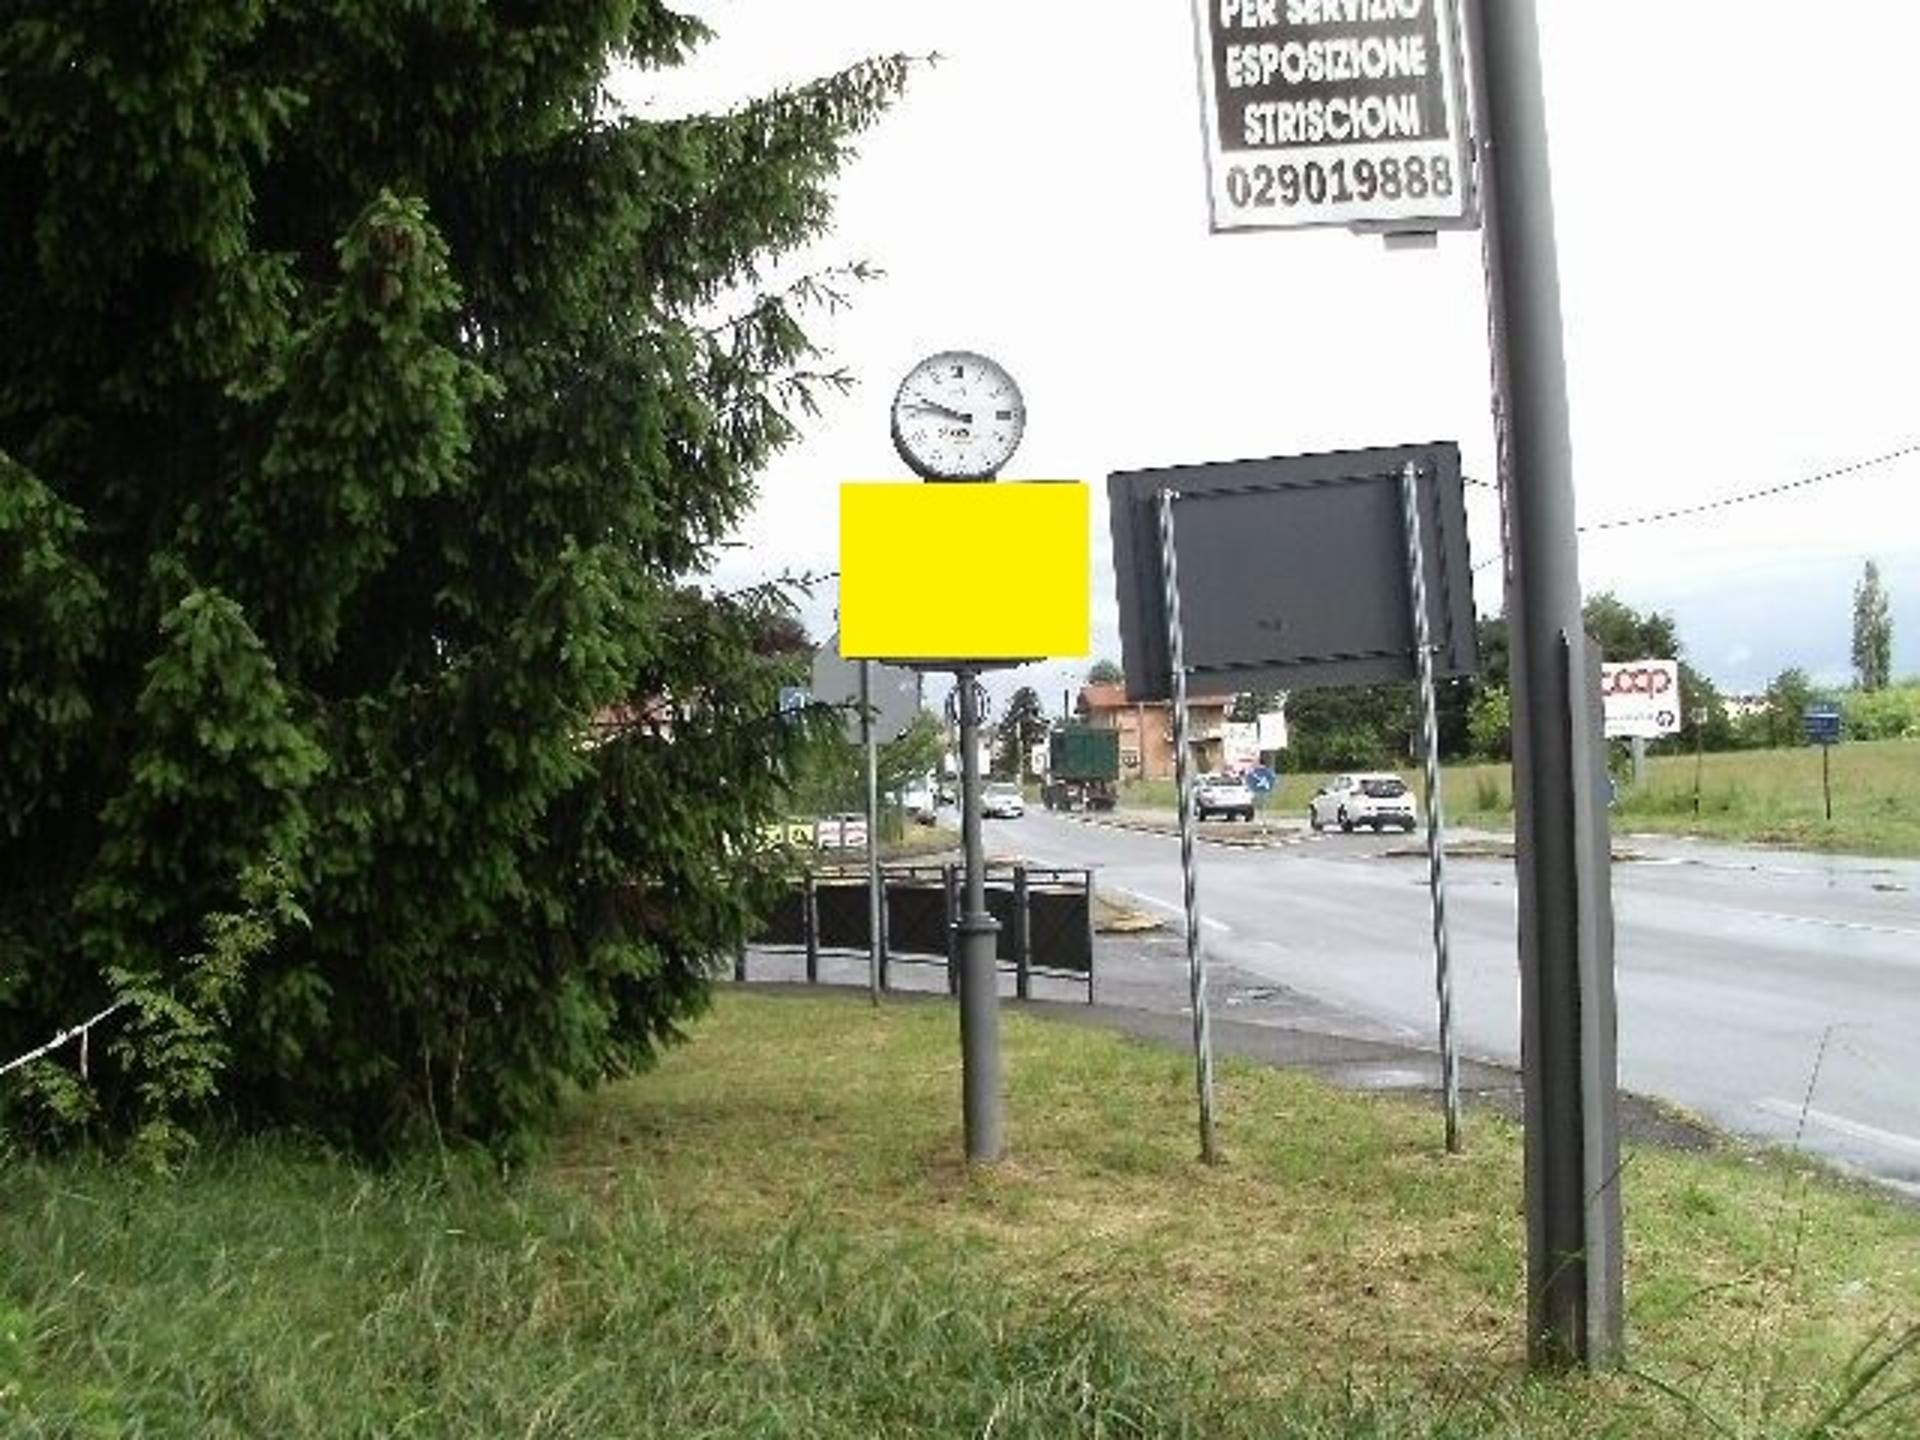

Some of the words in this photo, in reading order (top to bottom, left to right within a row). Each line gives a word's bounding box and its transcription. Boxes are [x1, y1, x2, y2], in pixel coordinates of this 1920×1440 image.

[1220, 0, 1278, 28] PER
[1226, 36, 1427, 88] ESPOSIZIONE
[1244, 95, 1420, 145] STRISCIONI
[1227, 154, 1452, 208] 029019888
